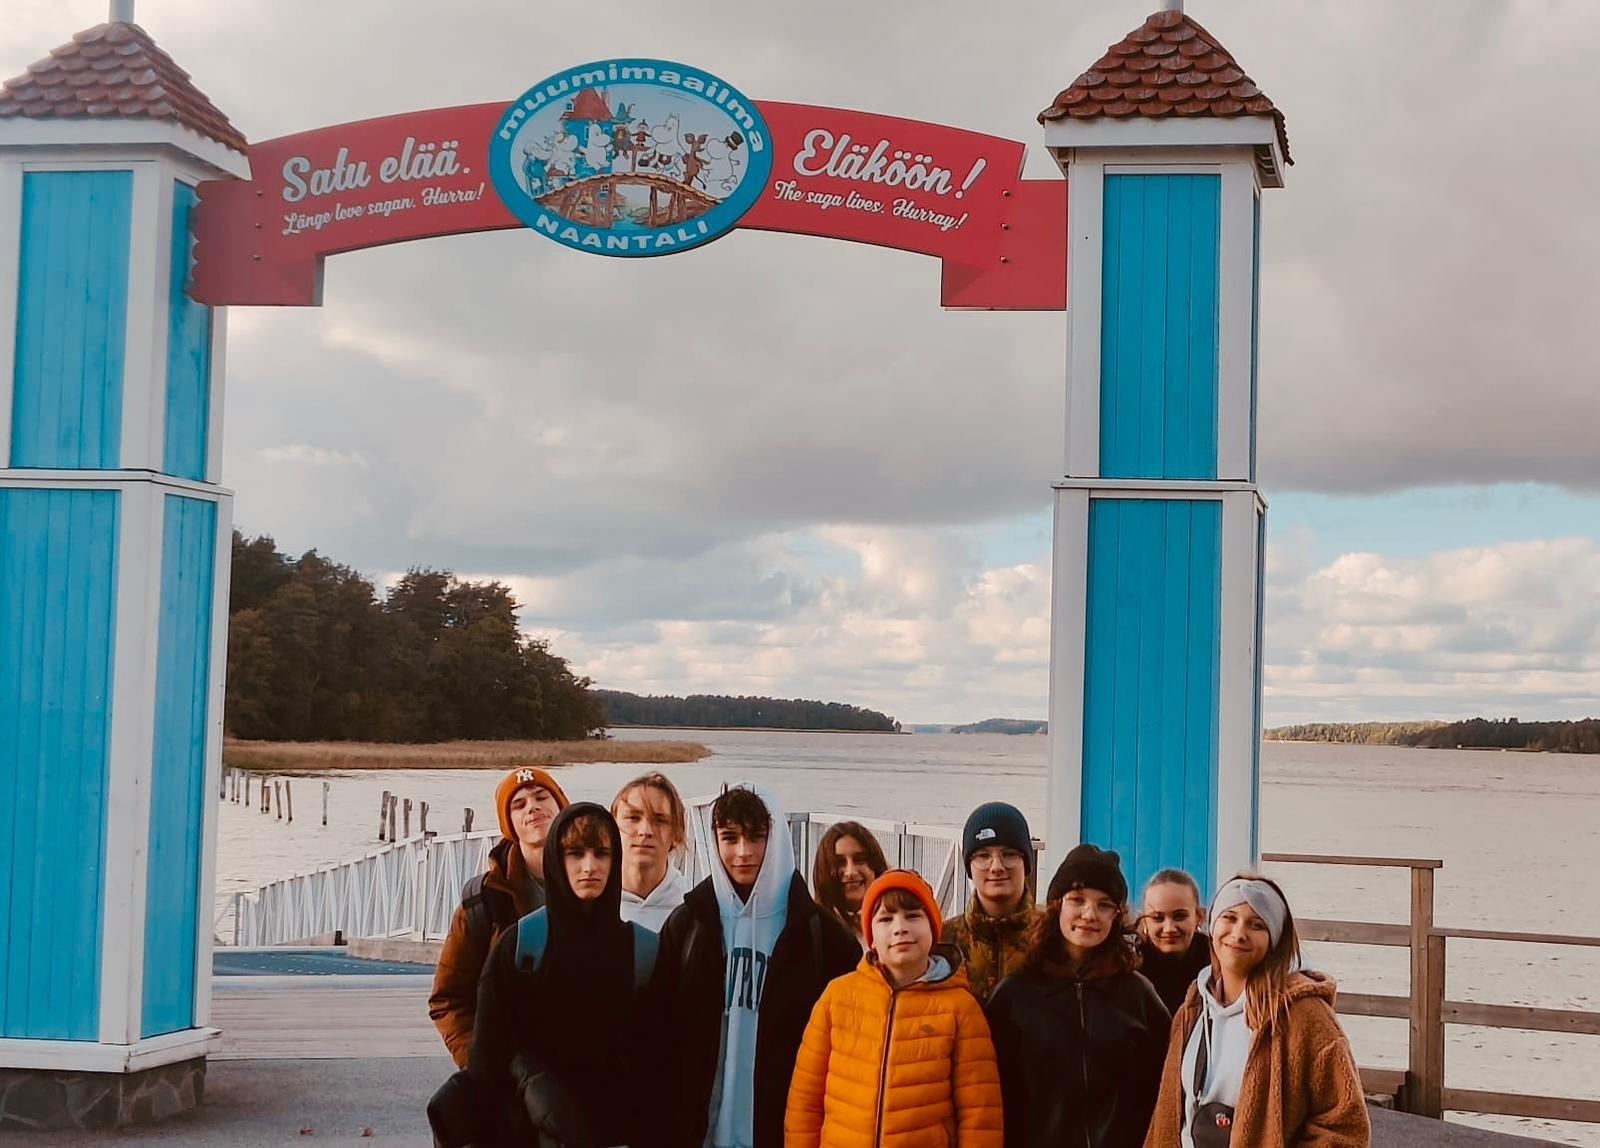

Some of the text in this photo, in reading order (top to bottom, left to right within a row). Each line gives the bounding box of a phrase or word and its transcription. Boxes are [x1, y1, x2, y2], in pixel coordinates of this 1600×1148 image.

[499, 63, 763, 153] muumimaailma
[282, 136, 471, 202] Satu elää.
[335, 202, 366, 221] leve
[421, 182, 485, 206] Hurra!
[774, 180, 969, 231] The saga lives. Hurray!
[536, 213, 709, 250] NAANTALI
